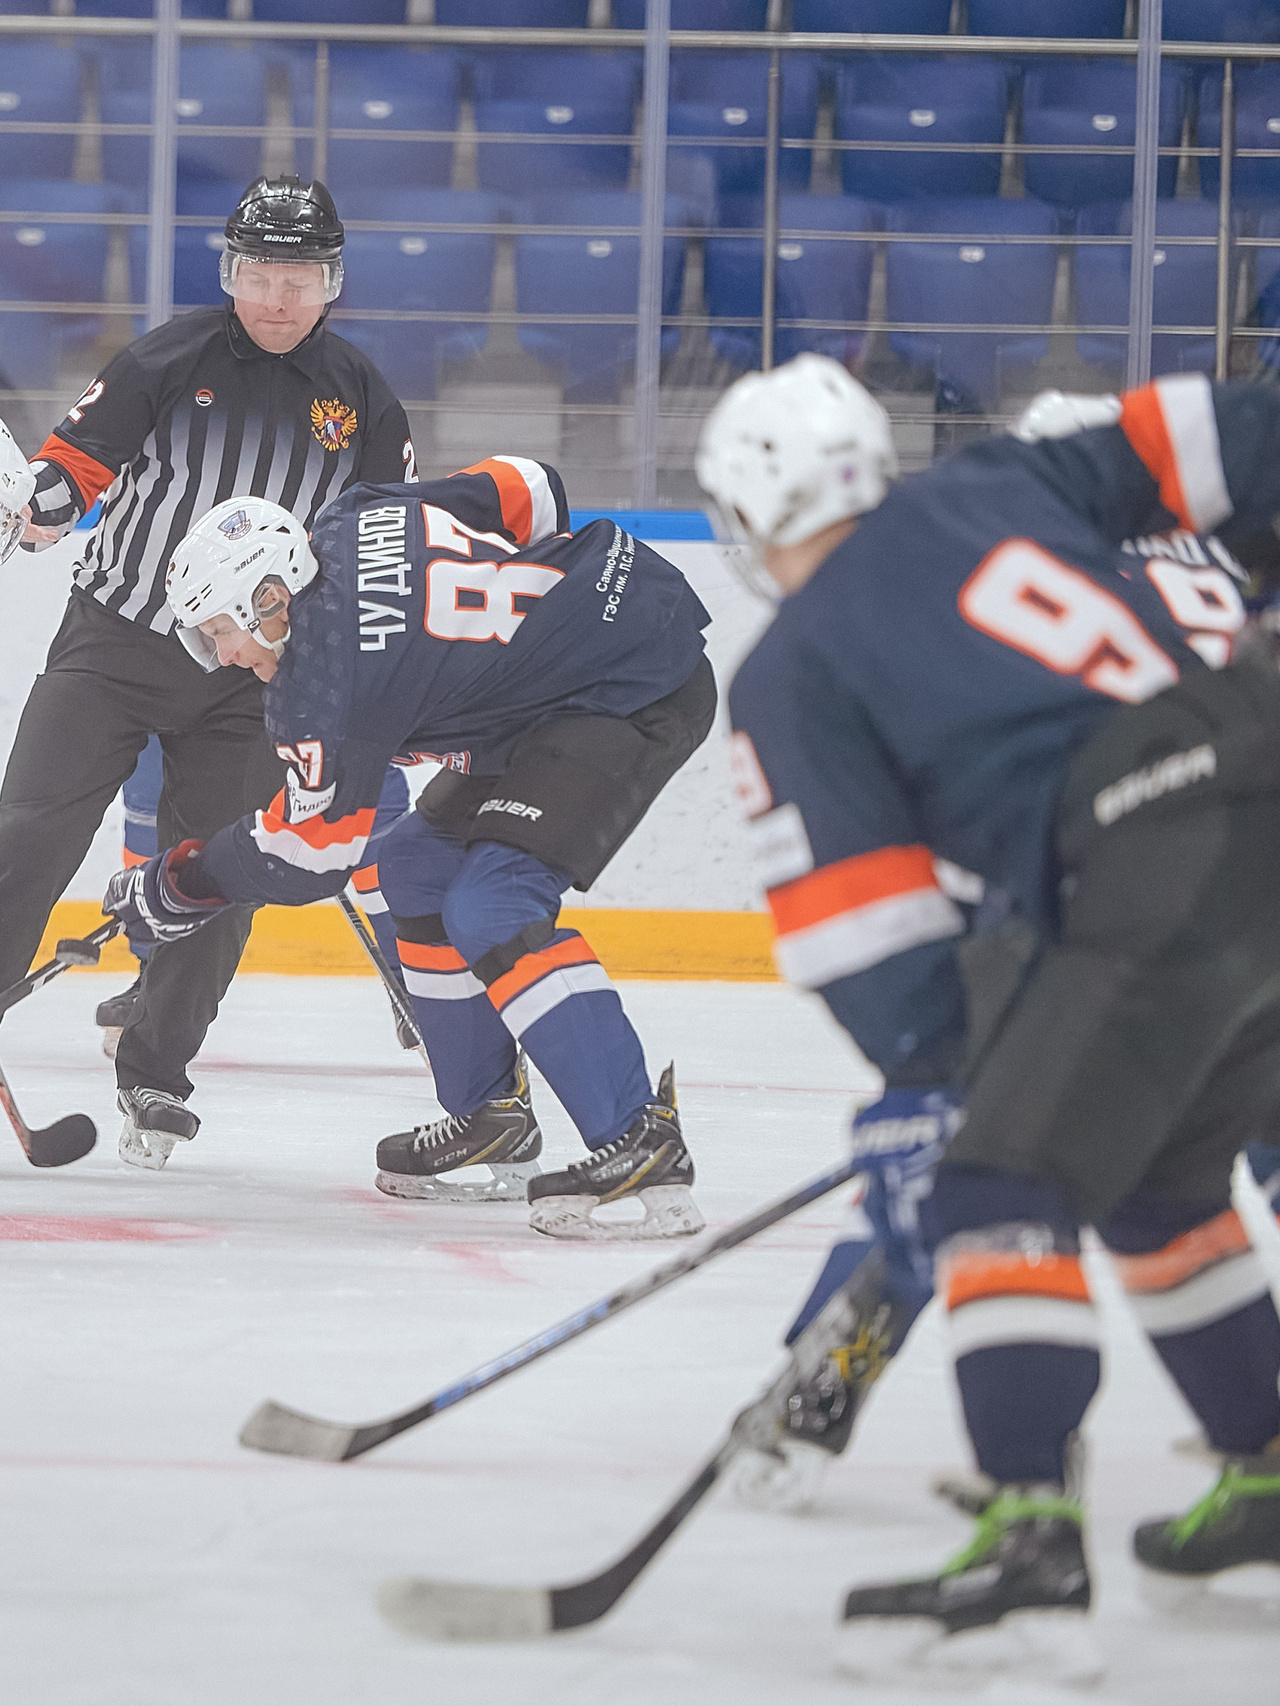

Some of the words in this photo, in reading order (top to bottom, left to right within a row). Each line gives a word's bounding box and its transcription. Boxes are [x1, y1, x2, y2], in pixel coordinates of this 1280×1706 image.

[263, 234, 302, 244] BAUER
[602, 594, 621, 622] ГЭС
[613, 573, 629, 594] им.
